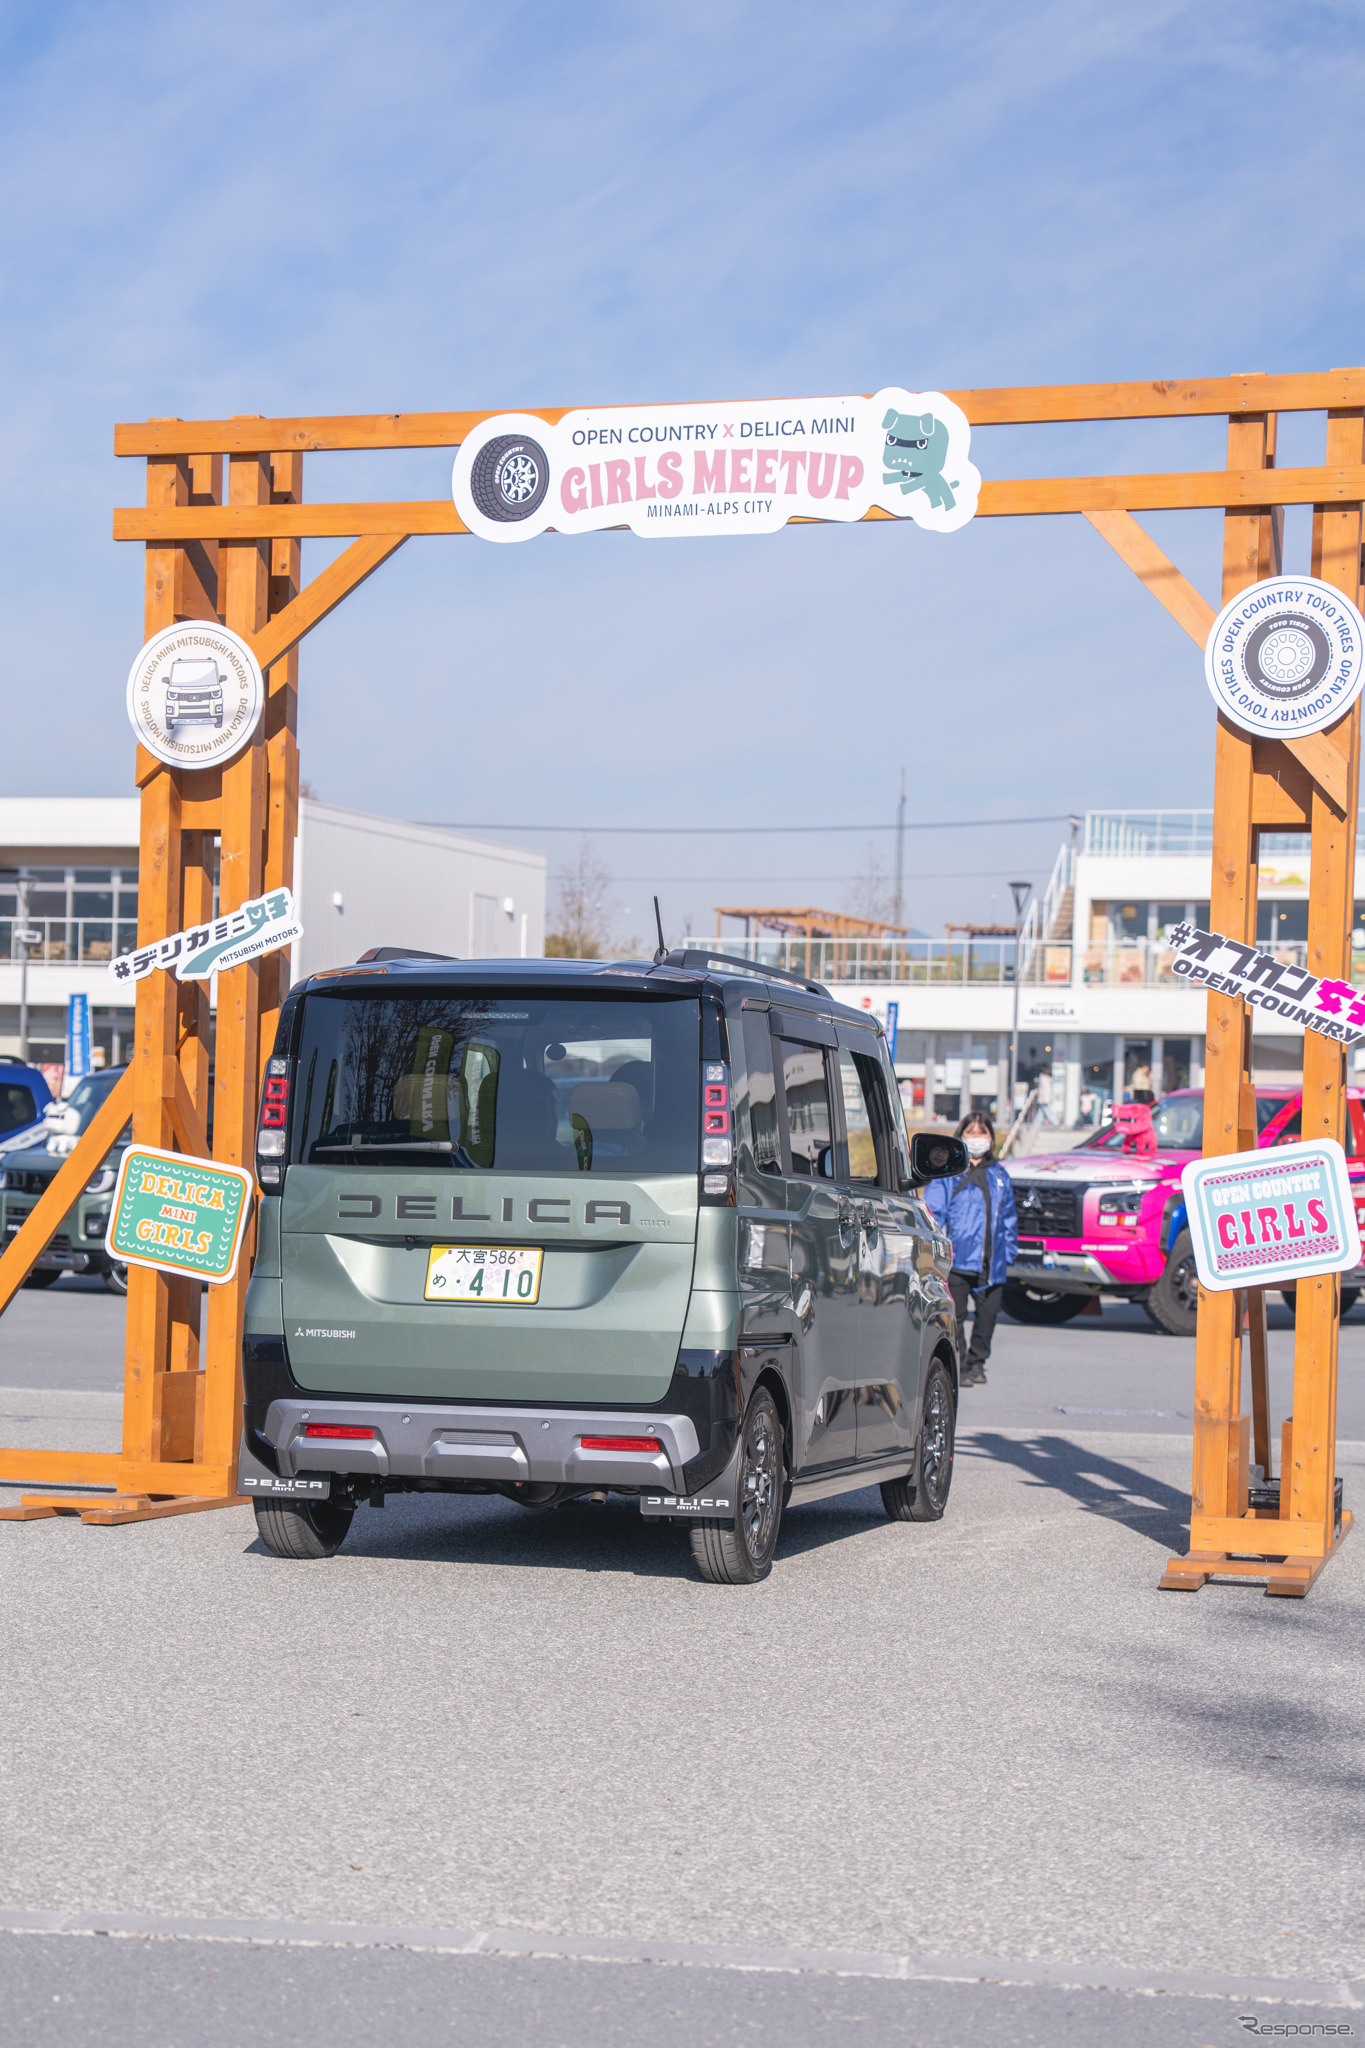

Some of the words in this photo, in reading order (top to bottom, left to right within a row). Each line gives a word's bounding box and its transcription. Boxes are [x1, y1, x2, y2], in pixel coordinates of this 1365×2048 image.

[571, 429, 621, 448] OPEN
[627, 423, 720, 445] COUNTRY
[722, 422, 735, 438] X
[739, 418, 806, 439] DELICA
[810, 416, 856, 435] MINI
[494, 464, 502, 484] OPEN
[499, 446, 524, 465] COUNTRY
[560, 451, 685, 515] GIRLS
[692, 447, 865, 501] MEETUP
[646, 501, 740, 518] MINAMI-ALPS
[743, 499, 774, 515] CITY
[1222, 617, 1245, 653] OPEN
[1242, 590, 1304, 620] COUNTRY
[1305, 593, 1337, 618] TOYO
[1333, 615, 1354, 654] TIRES
[1268, 619, 1288, 631] TOYO
[1288, 619, 1310, 631] TIRES
[141, 660, 159, 693] DELICA
[157, 643, 177, 661] MINI
[177, 636, 229, 655] MITSUBISHI
[226, 651, 249, 690] MOTORS
[1221, 659, 1239, 697] TIRES
[1329, 659, 1353, 695] OPEN
[1258, 678, 1292, 693] COUNTRY
[1292, 678, 1311, 693] OPEN
[141, 700, 164, 738] MOTORS
[232, 698, 248, 730] DELICA
[1238, 693, 1268, 719] TOYO
[1271, 693, 1333, 722] COUNTRY
[160, 736, 213, 754] MITSUBISHI
[214, 729, 233, 745] MINI
[219, 940, 264, 965] MITSUBISHI
[264, 926, 299, 948] MOTORS
[1172, 959, 1242, 996] OPEN
[1246, 989, 1363, 1043] COUNTRY
[140, 1173, 225, 1210] DELICA
[1211, 1184, 1251, 1206] OPEN
[1252, 1172, 1321, 1200] COUNTRY
[160, 1207, 196, 1223] MINI
[338, 1194, 631, 1225] DELICA
[1217, 1197, 1329, 1250] GIRLS
[137, 1220, 213, 1254] GIRLS
[306, 1328, 356, 1339] MITSUBISHI
[244, 1478, 323, 1489] DELICA
[647, 1497, 729, 1507] DELICA
